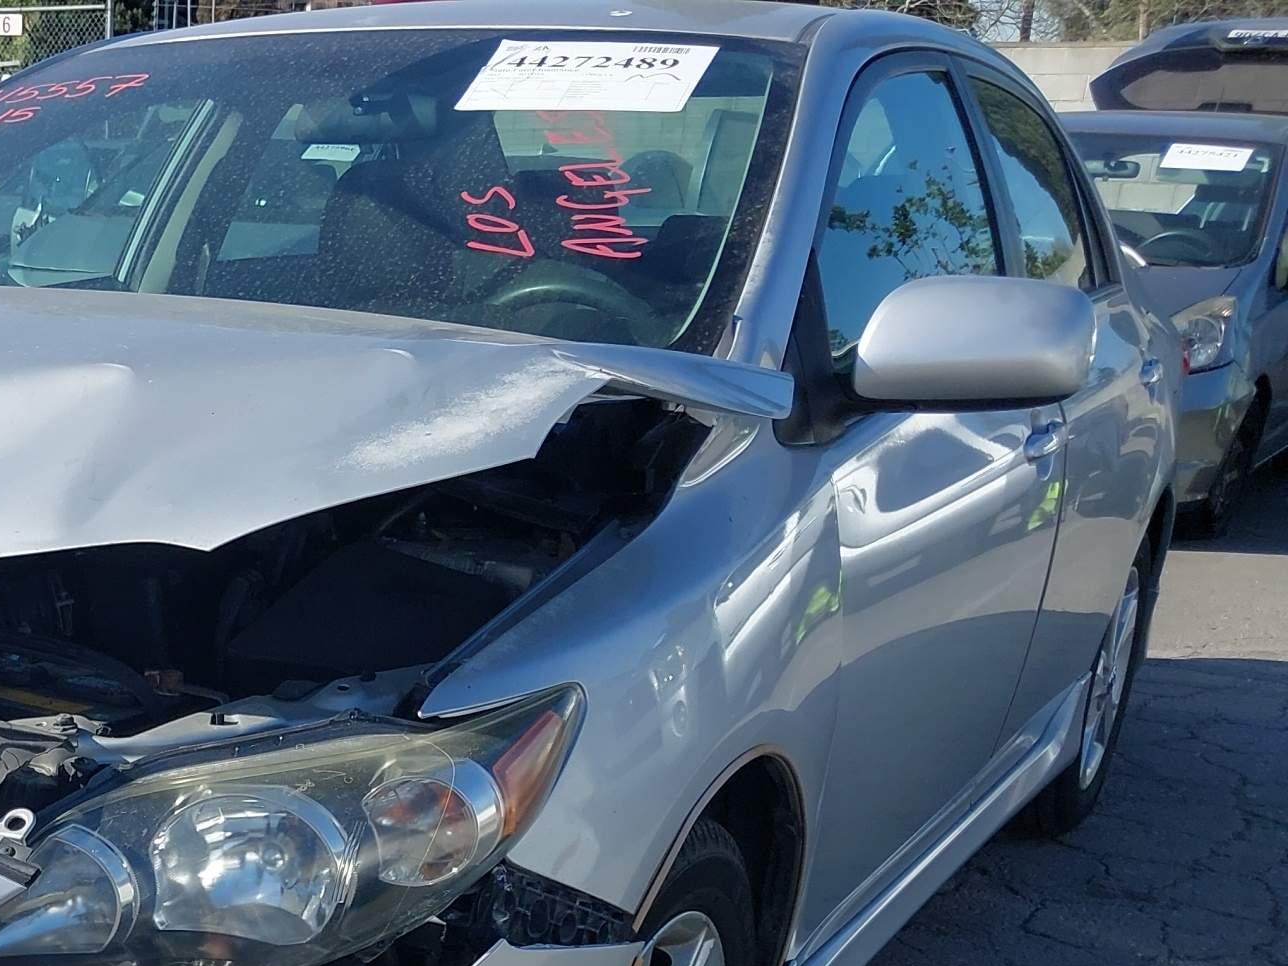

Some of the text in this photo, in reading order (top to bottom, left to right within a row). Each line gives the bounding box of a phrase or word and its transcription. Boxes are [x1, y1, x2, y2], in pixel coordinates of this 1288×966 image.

[2, 16, 11, 33] 6
[507, 55, 681, 70] 44272489
[461, 186, 535, 257] LOS
